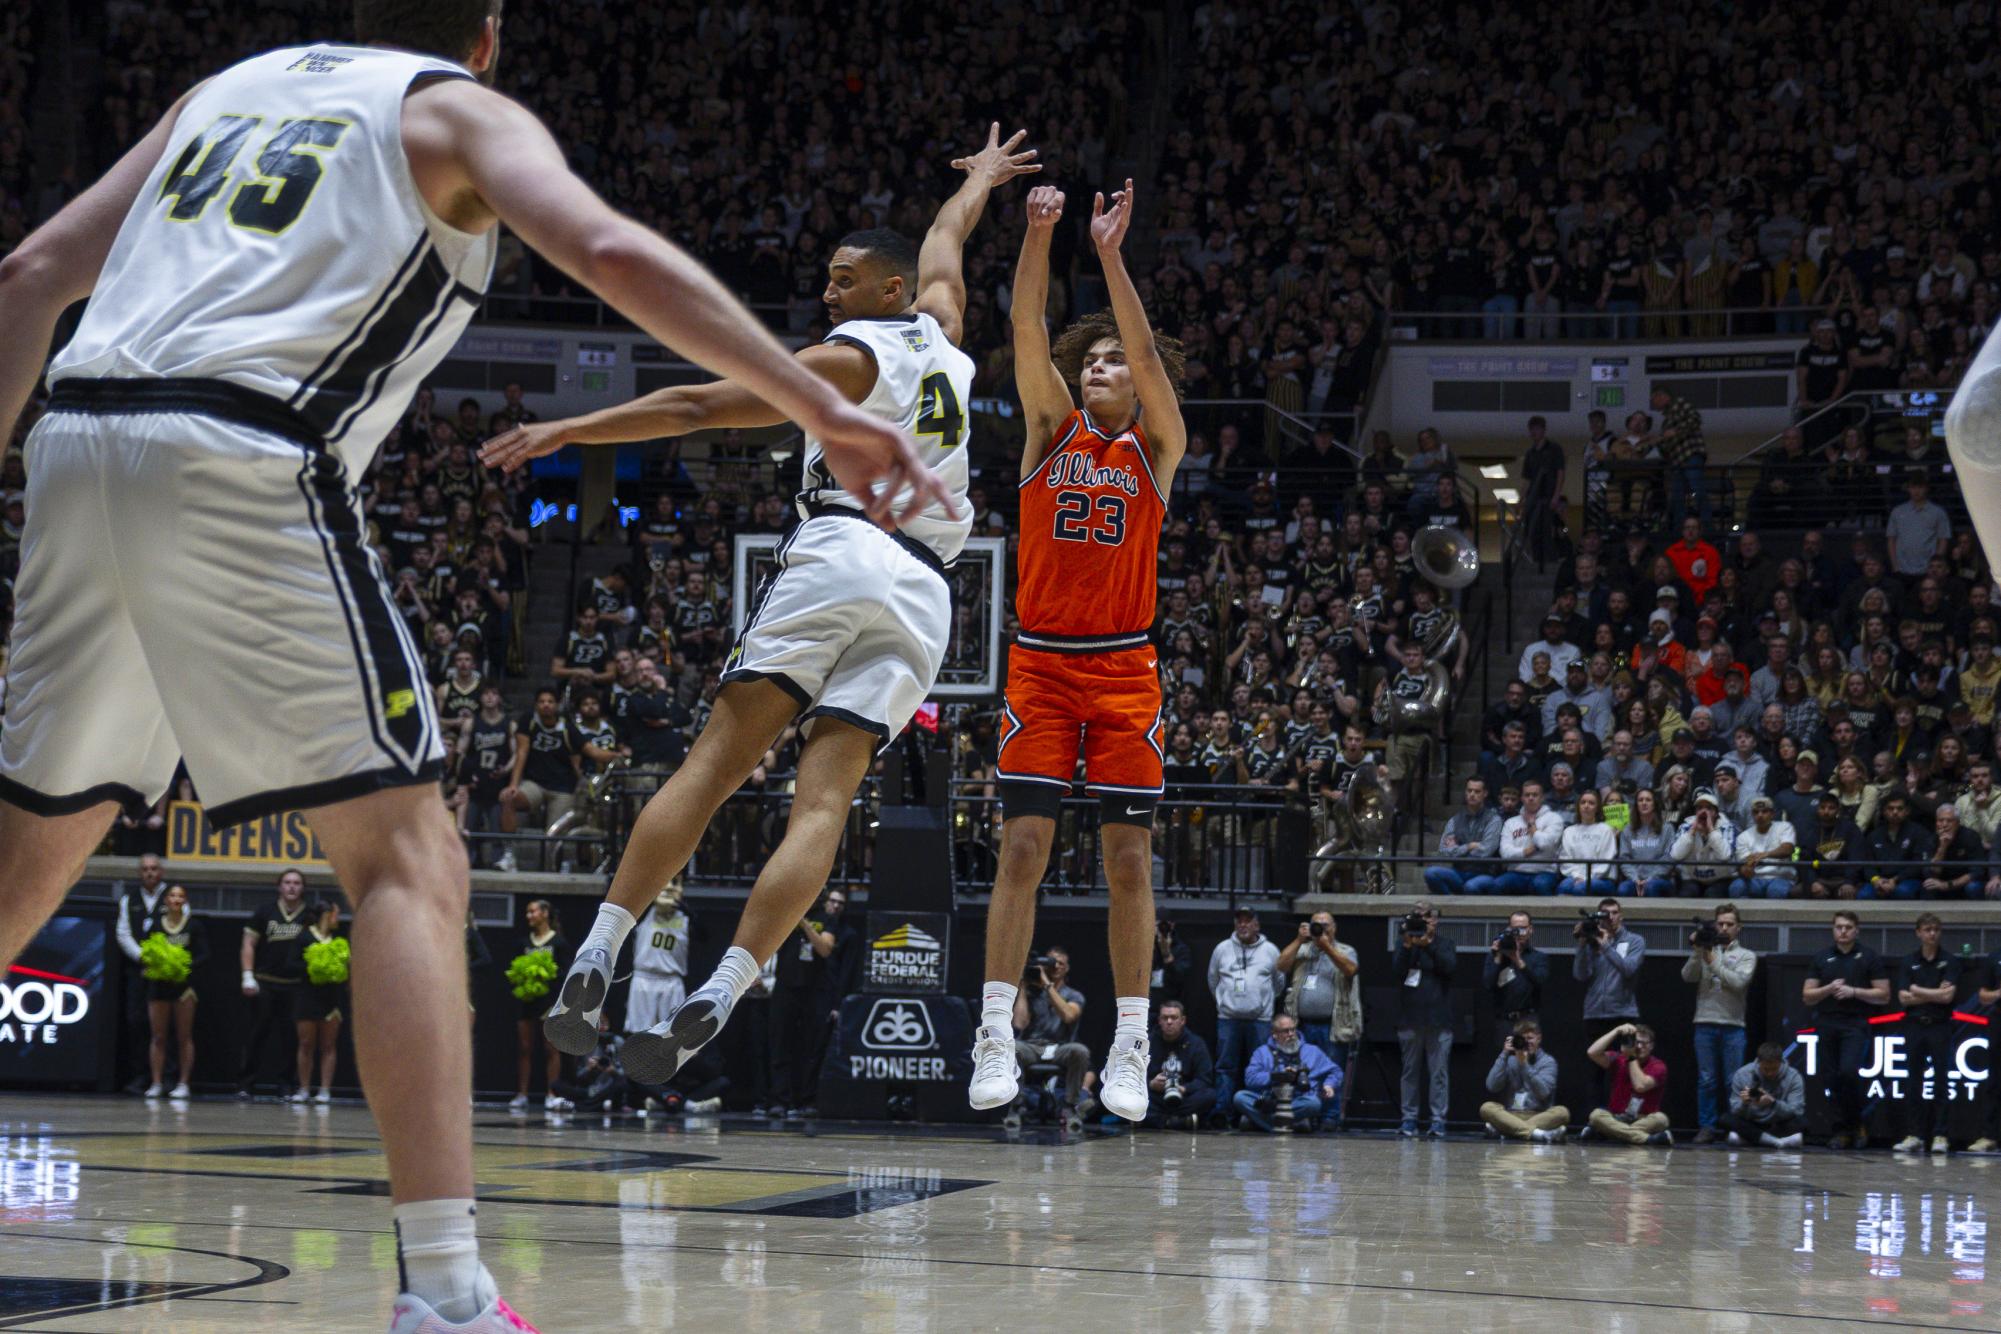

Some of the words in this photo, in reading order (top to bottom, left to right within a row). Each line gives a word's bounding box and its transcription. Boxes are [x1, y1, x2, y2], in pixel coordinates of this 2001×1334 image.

[155, 112, 353, 236] 45
[914, 369, 965, 449] 4
[1047, 451, 1140, 497] Illinois
[1053, 490, 1127, 547] 23
[652, 931, 676, 951] 00
[871, 950, 941, 965] PURDUE
[871, 963, 940, 978] FEDERAL
[850, 1055, 947, 1081] PIONEER
